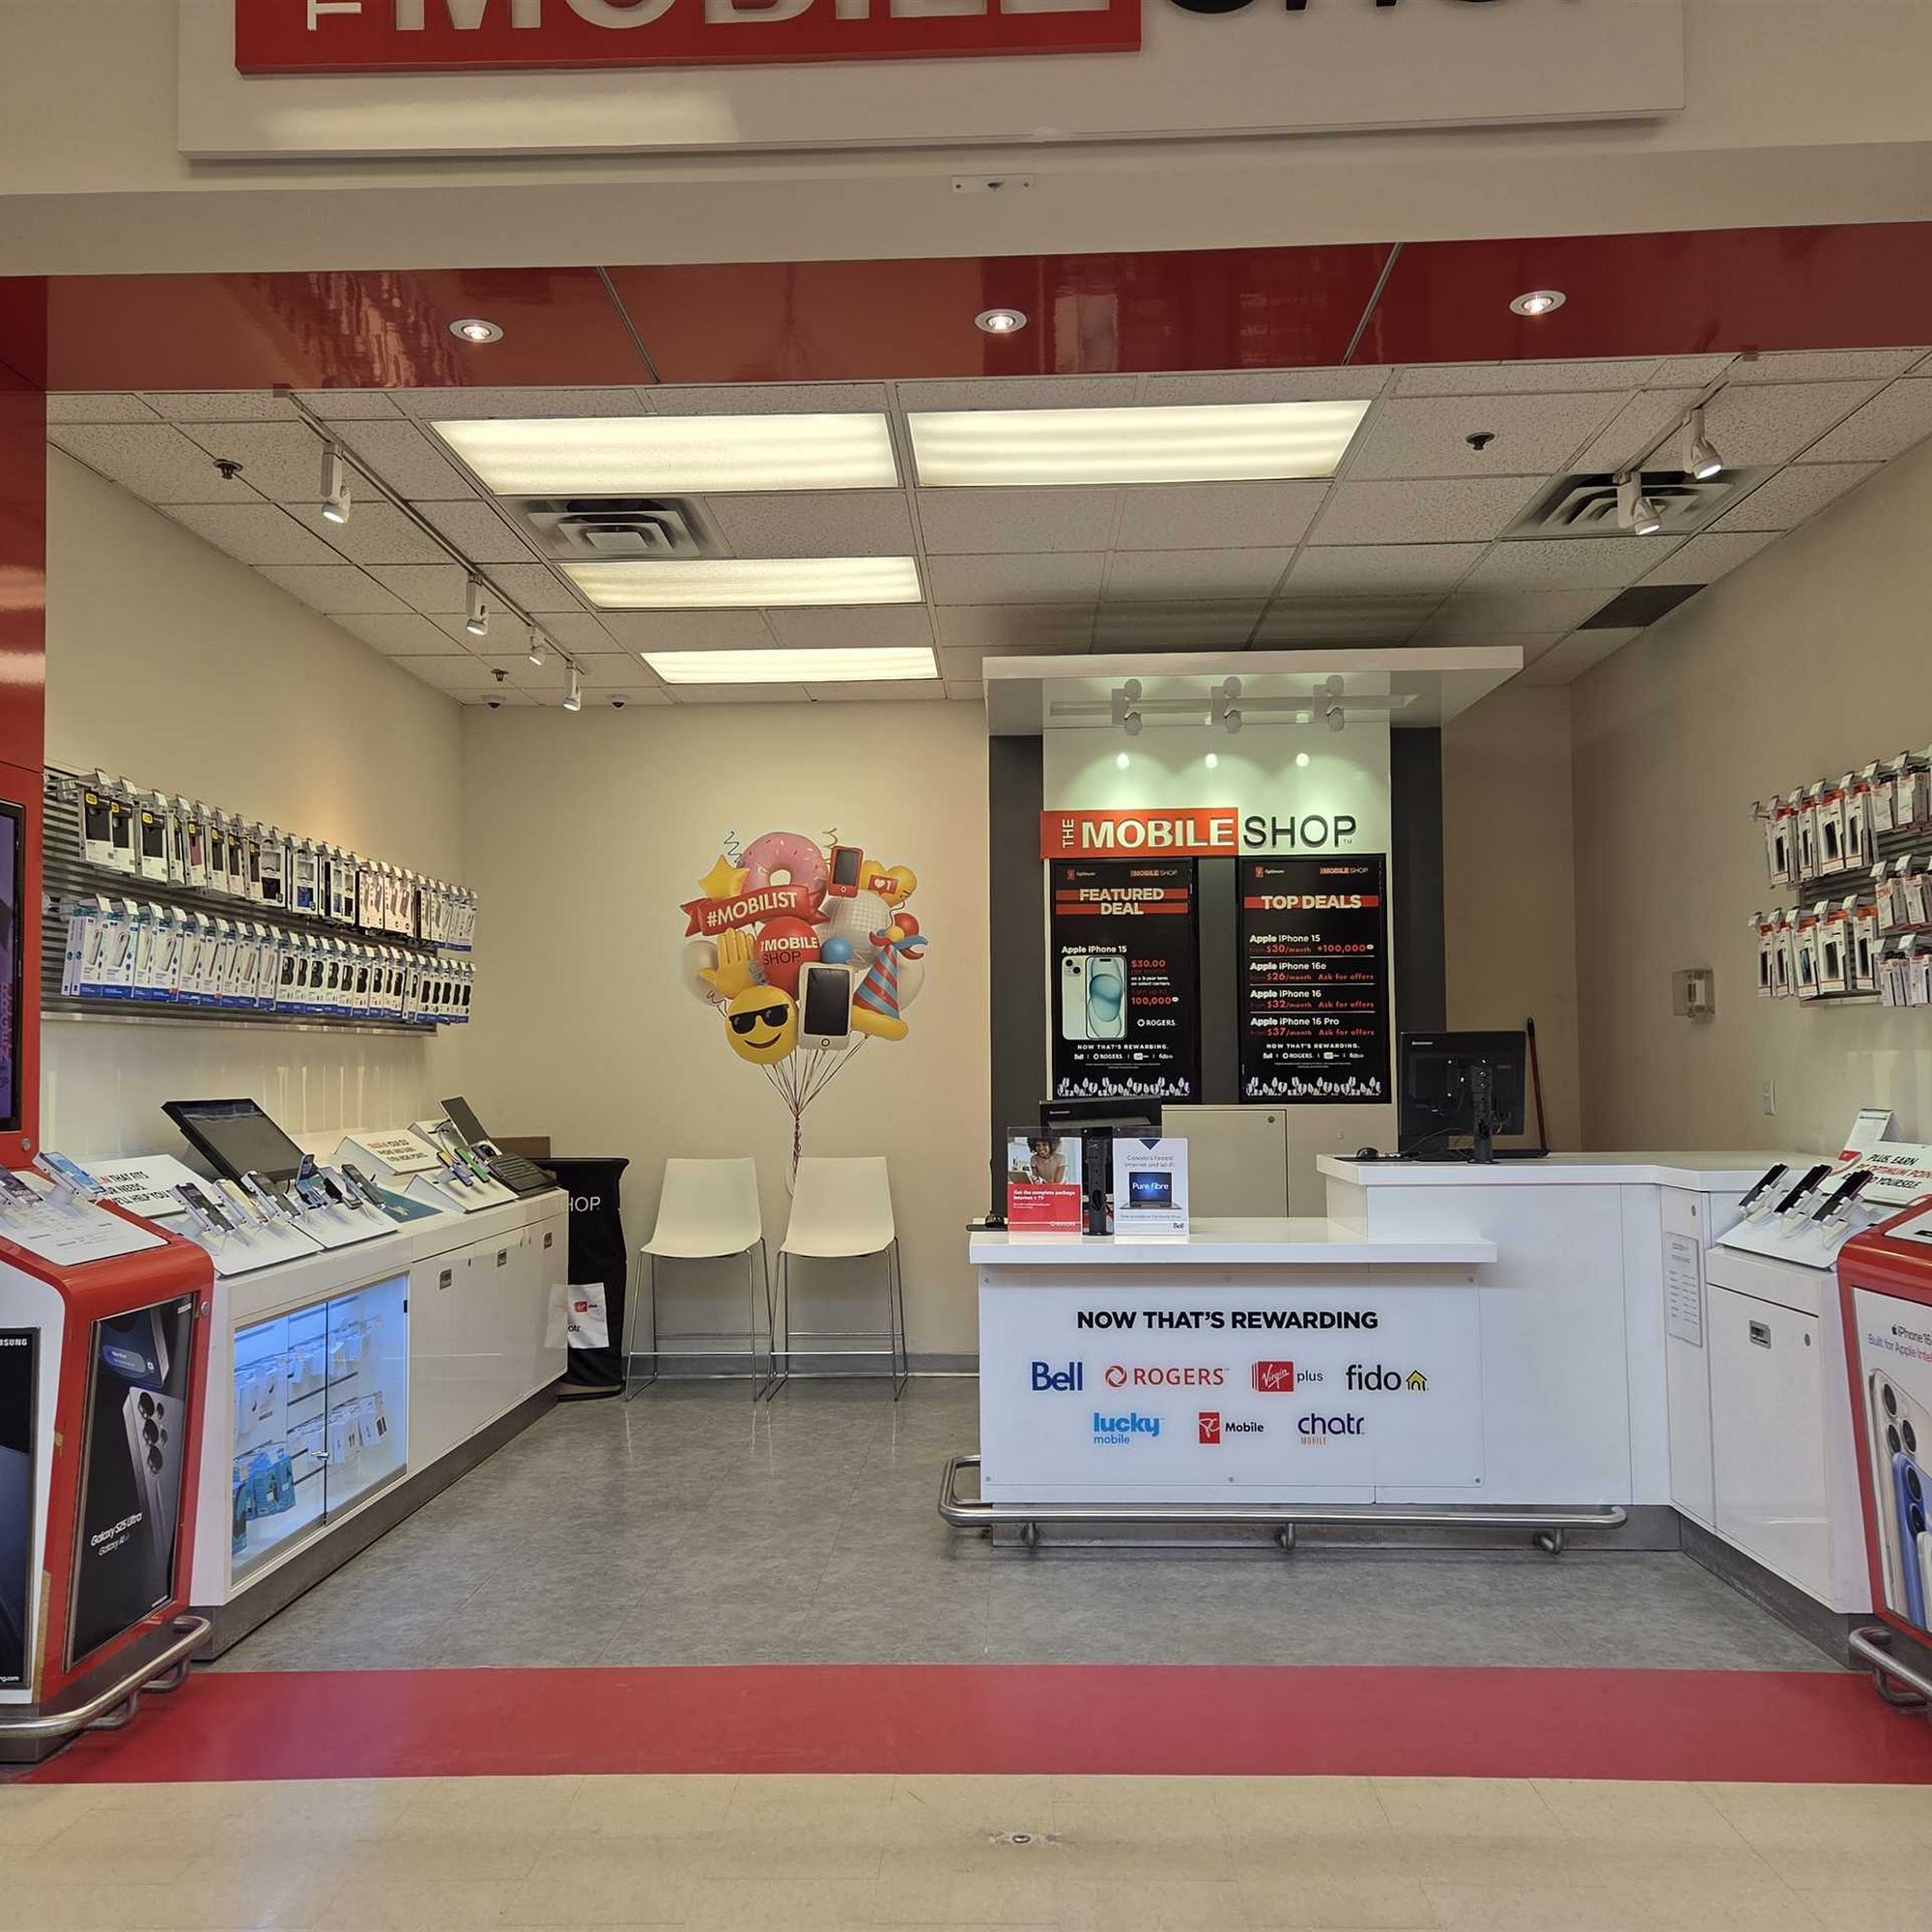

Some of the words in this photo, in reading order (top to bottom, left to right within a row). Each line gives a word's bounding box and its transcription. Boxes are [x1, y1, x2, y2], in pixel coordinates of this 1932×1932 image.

[1063, 819, 1074, 848] THE
[1081, 818, 1235, 848] MOBILE
[1243, 815, 1356, 848] SHOP
[1080, 888, 1164, 901] FEATURED
[1101, 903, 1144, 915] DEAL
[1261, 895, 1298, 909] TOP
[1302, 895, 1362, 909] DEALS
[707, 892, 797, 927] #MOBILIST
[765, 937, 818, 952] MOBILE
[1250, 935, 1277, 944] Apple
[1062, 946, 1086, 955] Apple
[1317, 945, 1366, 953] +100,000
[763, 951, 801, 965] SHOP
[1250, 963, 1277, 971] Apple
[1250, 990, 1277, 998] Apple
[1131, 997, 1171, 1006] 100,000
[1250, 1018, 1278, 1026] Apple
[1078, 1311, 1137, 1329] NOW
[1143, 1311, 1225, 1329] THAT'S
[1232, 1311, 1378, 1329] REWARDING
[1032, 1362, 1082, 1391] Bell
[1134, 1368, 1224, 1385] ROGERS
[1262, 1364, 1290, 1389] Virgin
[1297, 1370, 1323, 1384] plus
[1345, 1364, 1401, 1391] fido
[1094, 1413, 1160, 1437] lucky
[1225, 1422, 1264, 1433] Mobile
[1297, 1413, 1364, 1435] chatr
[1094, 1434, 1130, 1444] mobile
[1300, 1437, 1327, 1445] MOBILE
[91, 1527, 115, 1546] Galaxy
